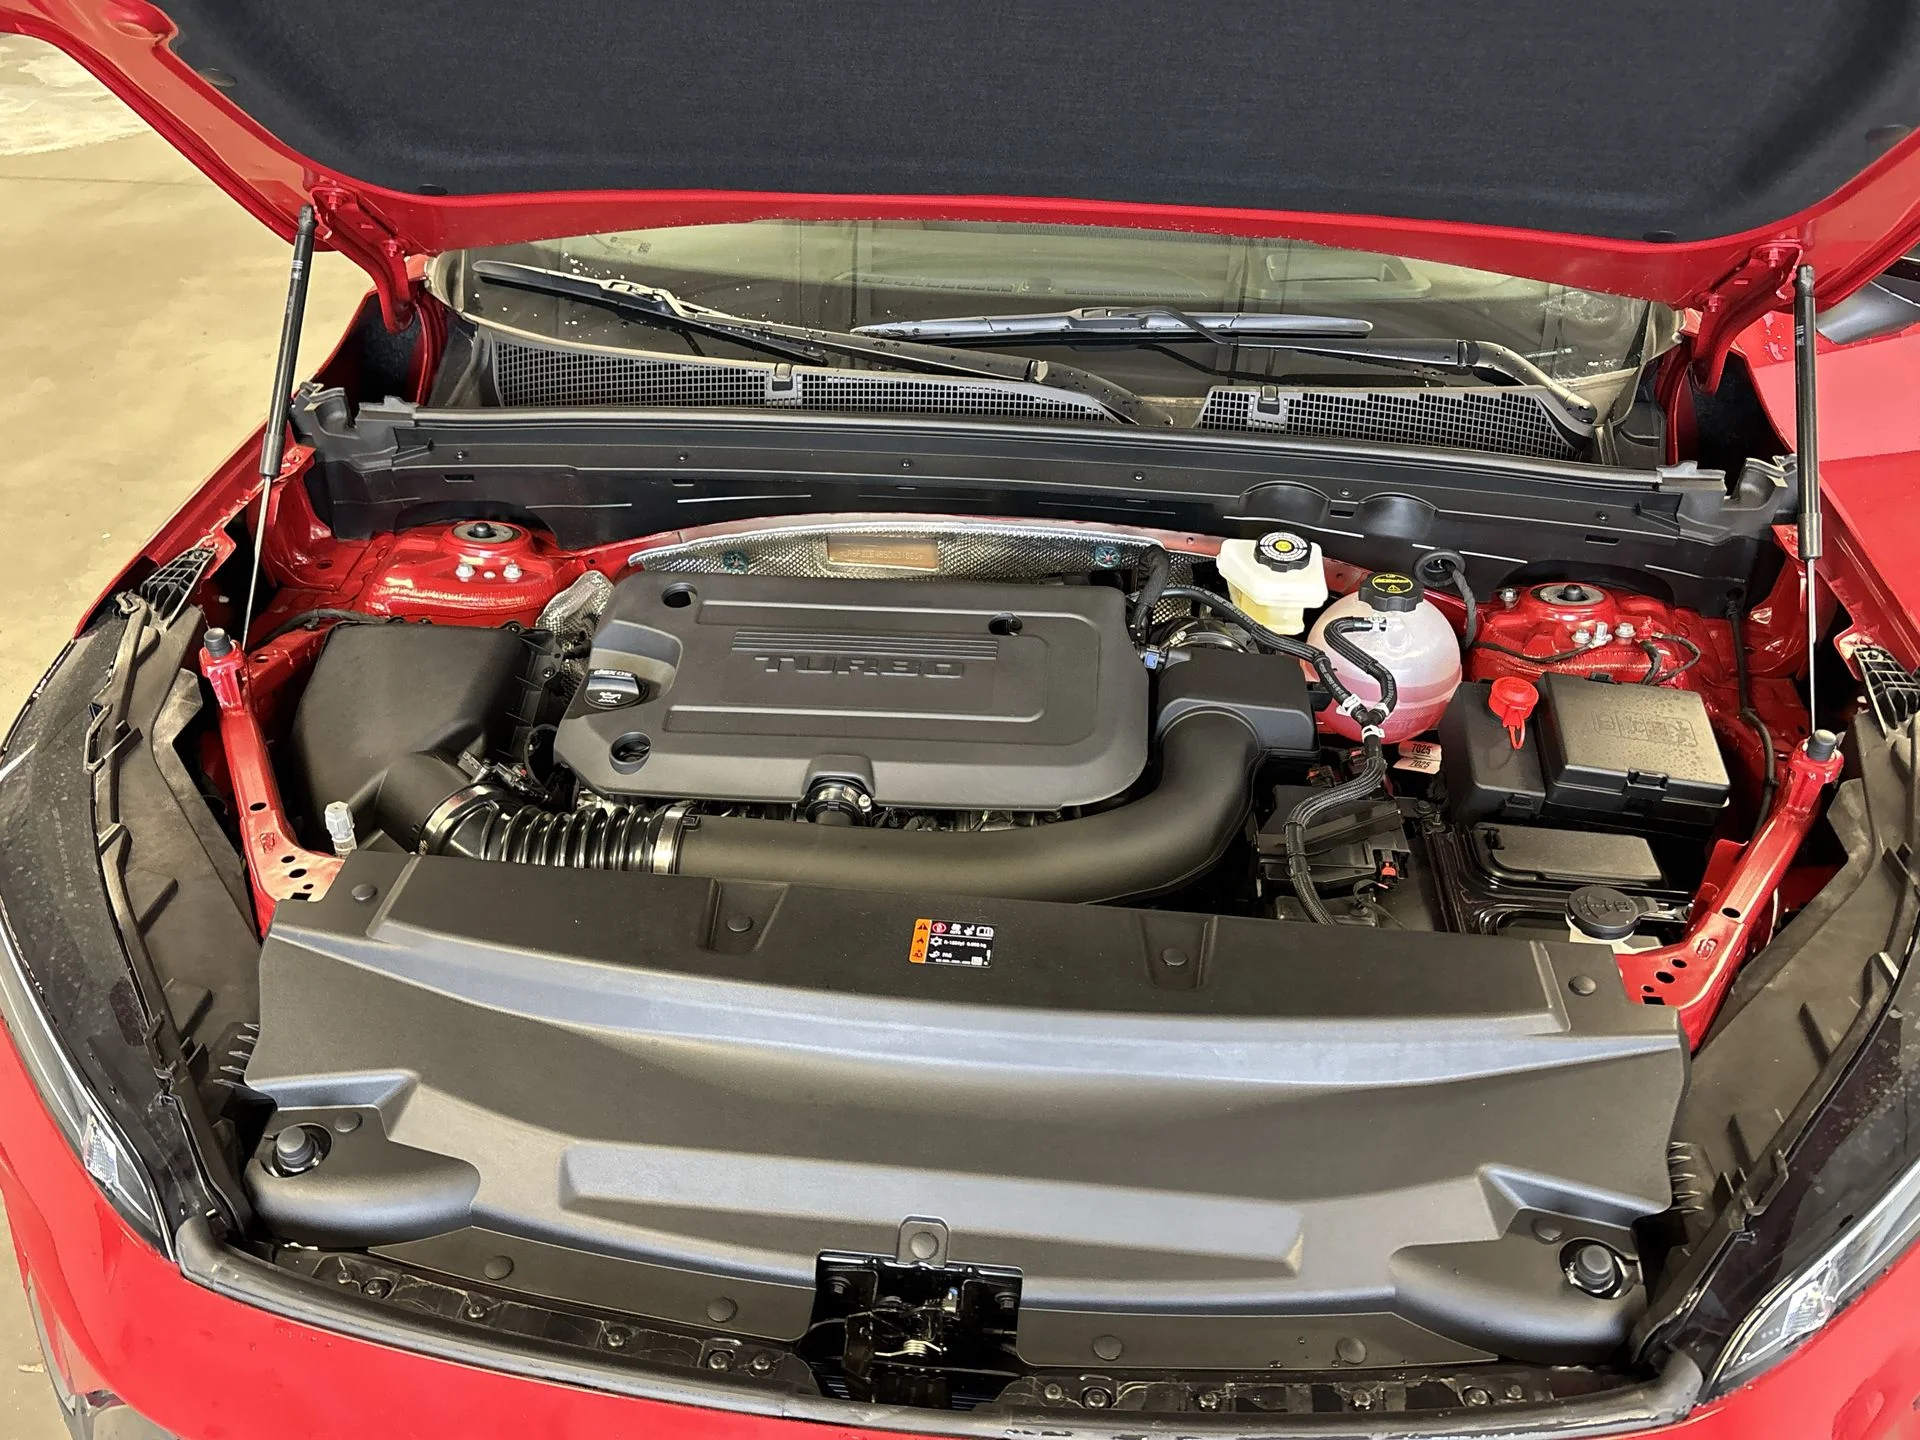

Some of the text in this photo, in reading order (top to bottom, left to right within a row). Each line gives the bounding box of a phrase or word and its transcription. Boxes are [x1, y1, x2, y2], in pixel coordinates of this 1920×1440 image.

[754, 656, 965, 679] TURBO
[593, 669, 632, 677] dexos
[1411, 743, 1432, 755] 7025
[1409, 760, 1432, 768] 7025
